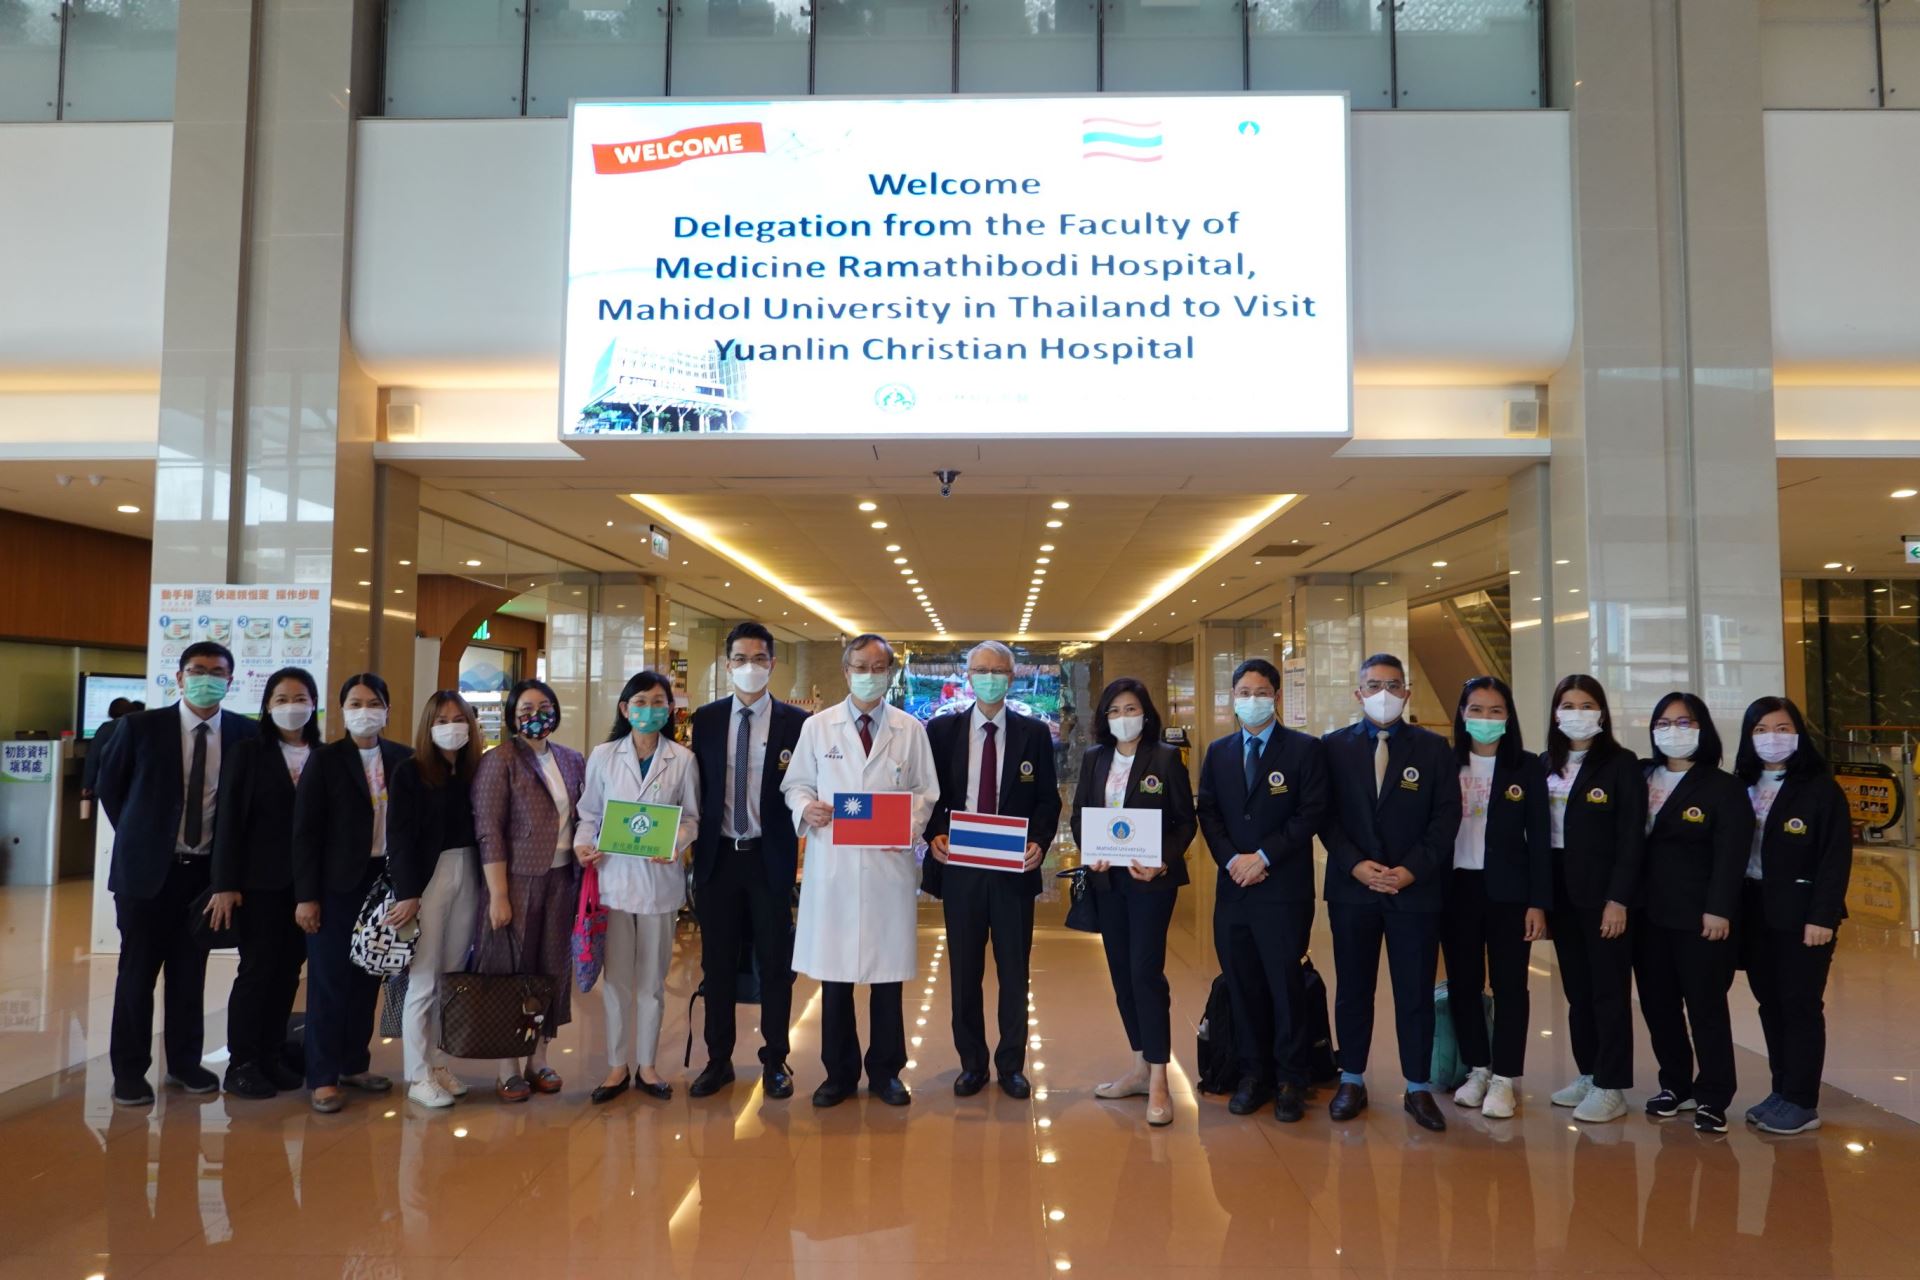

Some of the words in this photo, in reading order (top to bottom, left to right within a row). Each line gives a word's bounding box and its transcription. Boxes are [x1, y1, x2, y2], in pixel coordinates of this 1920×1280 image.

[614, 133, 744, 164] WELCOME
[868, 171, 1041, 196] Welcome
[674, 213, 871, 243] Delegation
[883, 212, 972, 237] from
[985, 213, 1046, 236] the
[1060, 212, 1191, 241] Faculty
[1203, 211, 1239, 235] of
[655, 254, 826, 280] Medicine
[839, 253, 1078, 278] Ramathibodi
[1091, 252, 1256, 282] Hospital,
[598, 296, 750, 321] Mahidol
[764, 296, 951, 325] University
[964, 295, 996, 318] in
[1009, 294, 1170, 318] Thailand
[1183, 297, 1220, 318] to
[1234, 294, 1316, 317] Visit
[714, 338, 849, 365] Yuanlin
[862, 337, 1027, 361] Christian
[1041, 335, 1193, 365] Hospital
[5, 746, 48, 758] 初診資料
